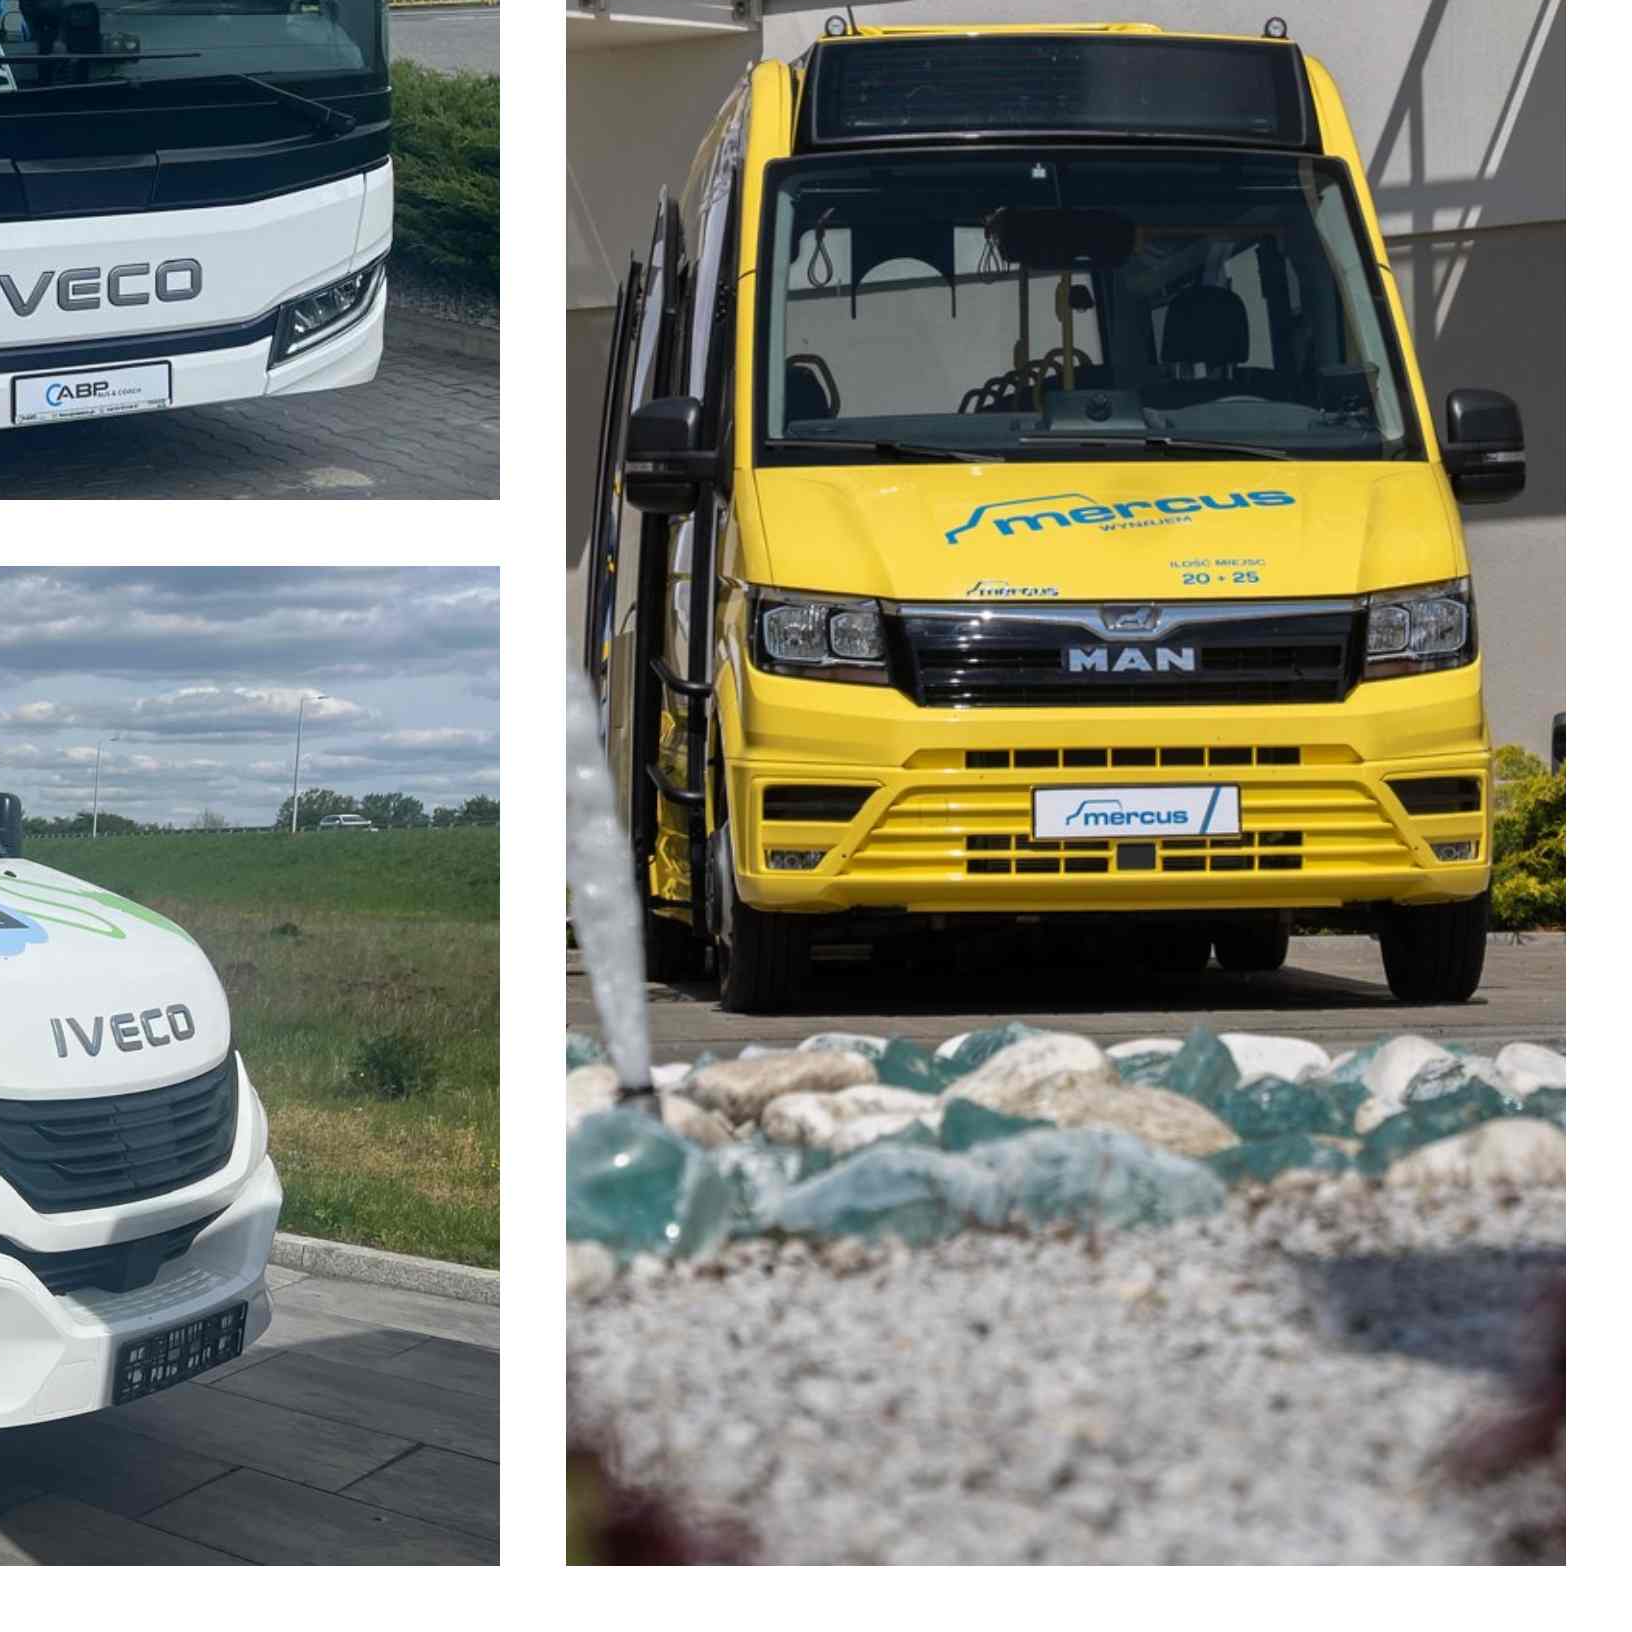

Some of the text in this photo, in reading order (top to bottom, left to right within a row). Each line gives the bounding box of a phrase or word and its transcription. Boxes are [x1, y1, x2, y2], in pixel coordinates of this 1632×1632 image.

[993, 490, 1297, 536] mercus
[1182, 572, 1210, 585] 20
[1232, 571, 1260, 584] 25
[1069, 647, 1195, 672] MAN
[1083, 809, 1189, 827] mercus
[49, 1003, 196, 1058] IVECO
